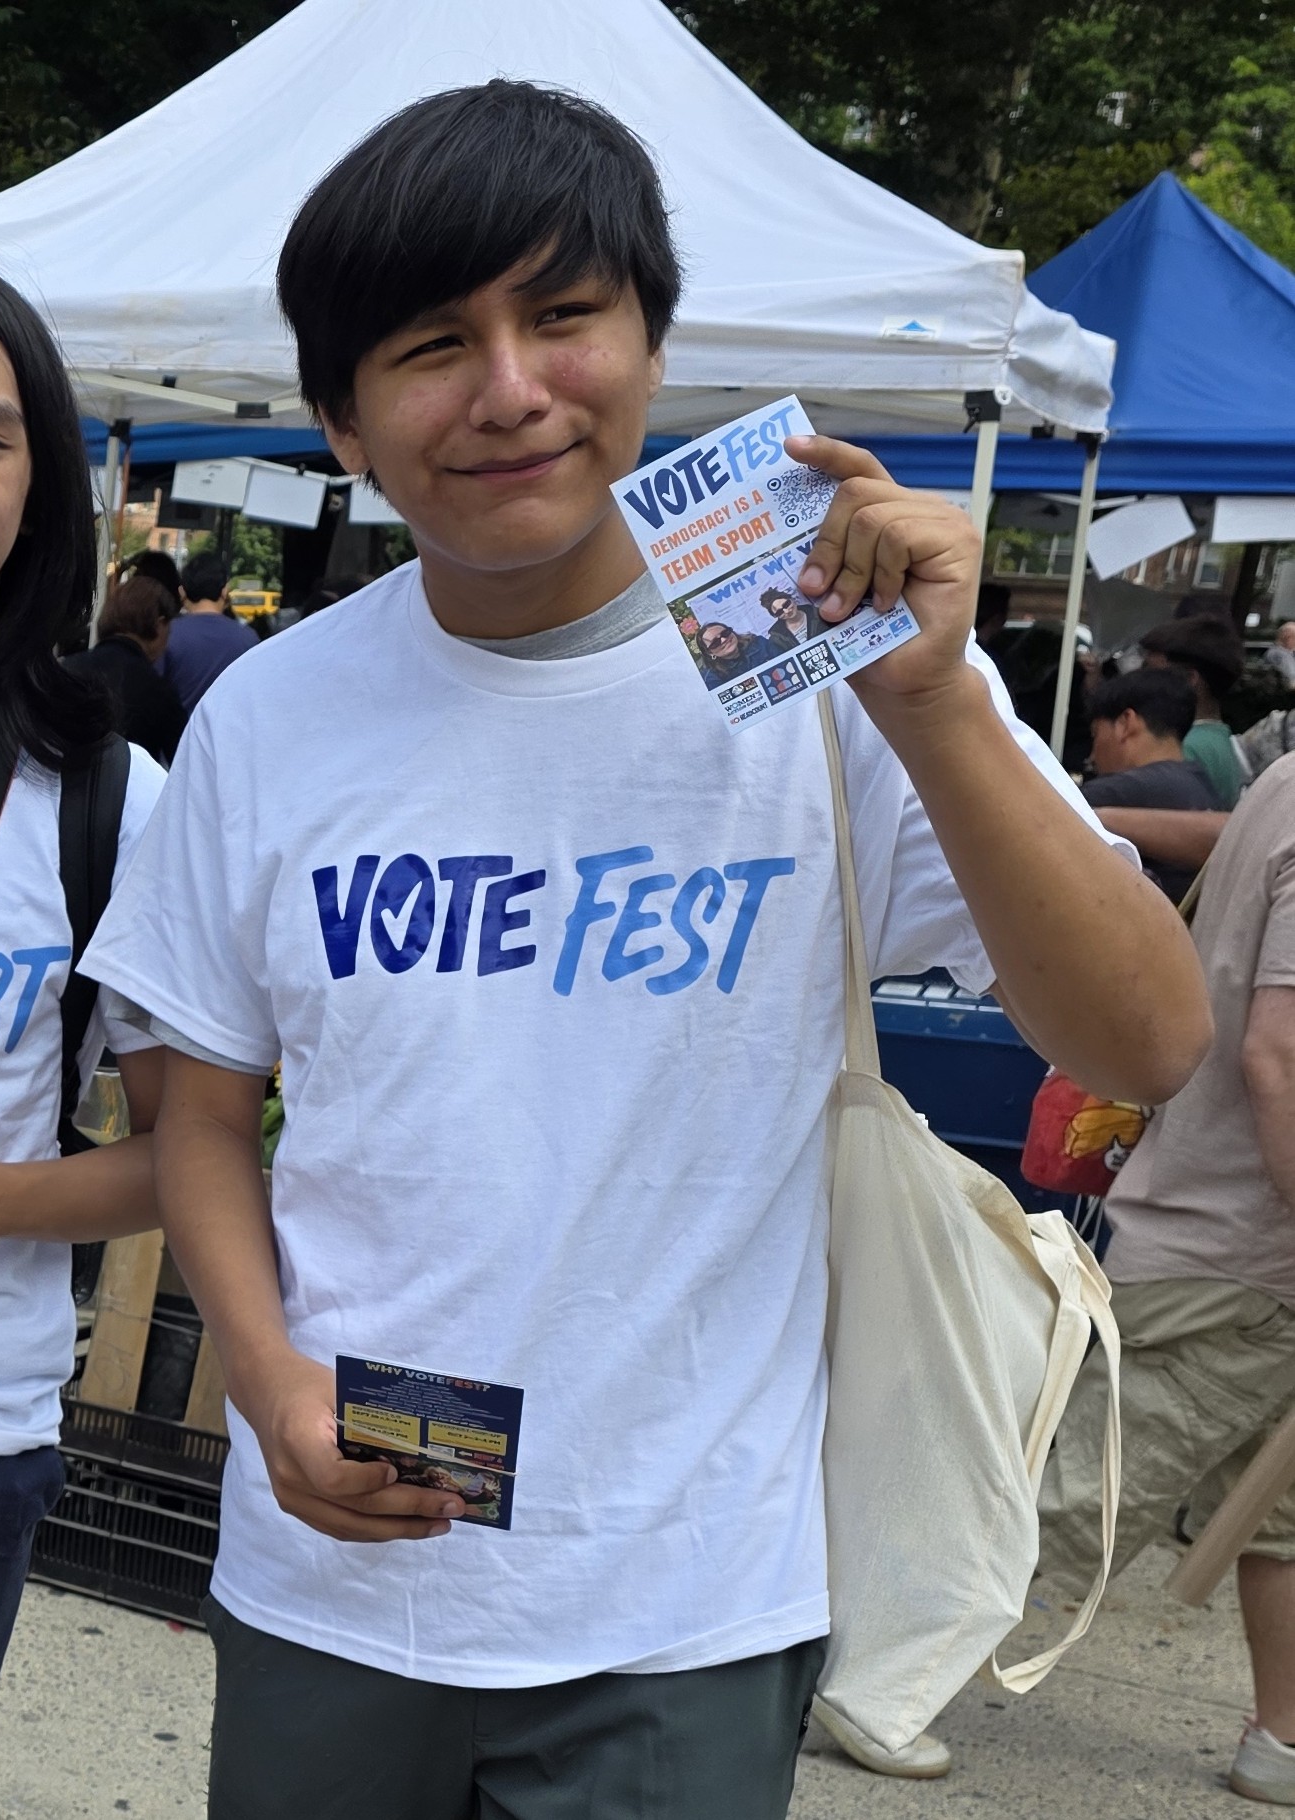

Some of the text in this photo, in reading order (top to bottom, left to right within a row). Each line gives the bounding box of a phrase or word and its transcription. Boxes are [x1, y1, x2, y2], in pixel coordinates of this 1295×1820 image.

[650, 489, 765, 559] DEMOCRACY IS A
[660, 511, 776, 586] TEAM SPORT
[707, 569, 758, 604] WHY
[762, 550, 797, 576] WE
[801, 643, 827, 661] HANDS
[810, 663, 837, 682] NYC
[312, 845, 796, 996] VOTE FEST
[365, 1361, 403, 1377] WHY
